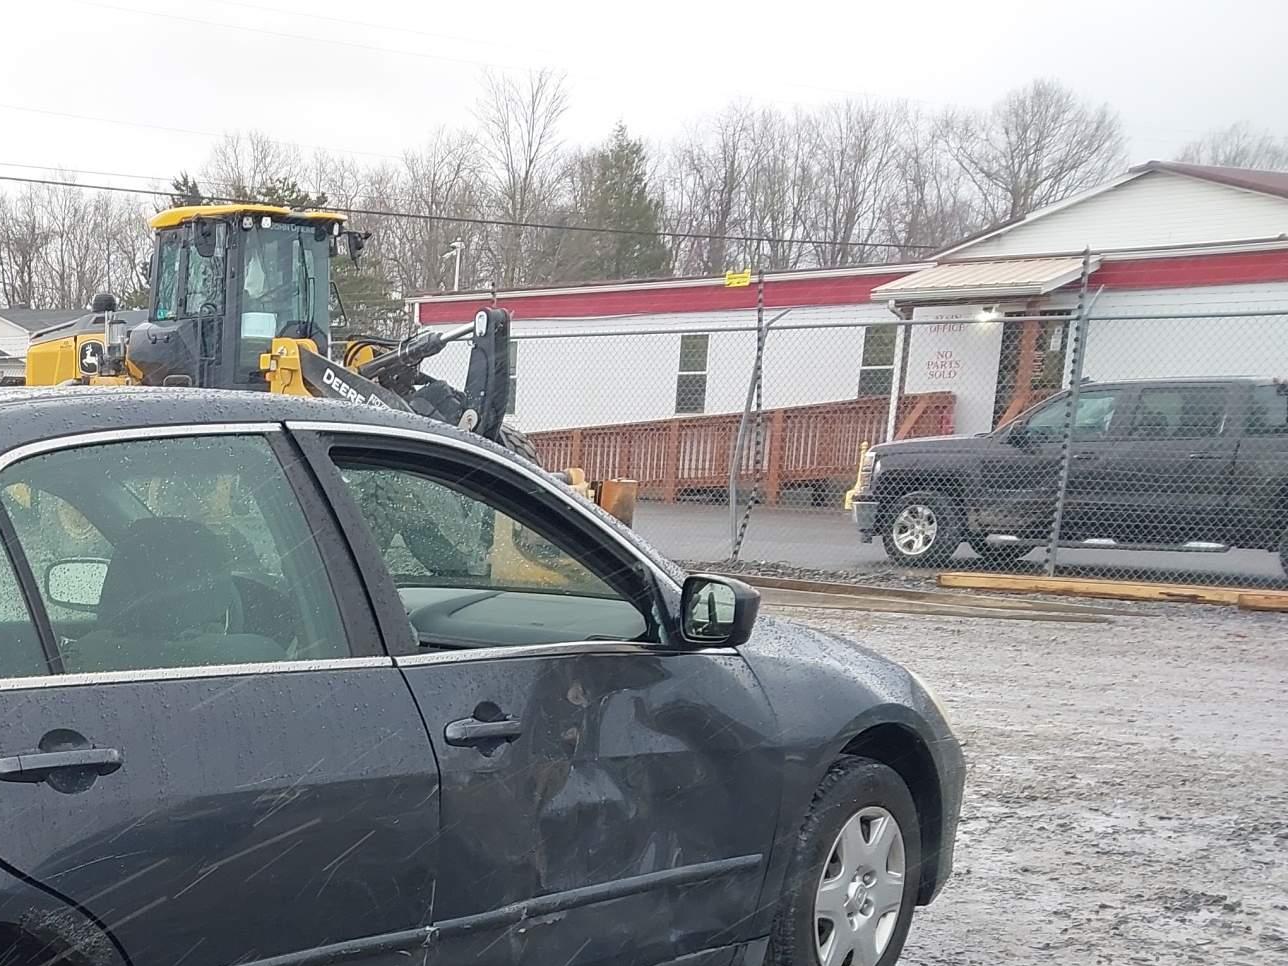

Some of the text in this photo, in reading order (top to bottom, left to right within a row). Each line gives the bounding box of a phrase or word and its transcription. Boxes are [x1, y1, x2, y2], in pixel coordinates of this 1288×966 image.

[936, 351, 953, 360] NO
[927, 360, 961, 370] PARTS
[928, 370, 957, 380] SOLD
[322, 367, 366, 406] DEERE
